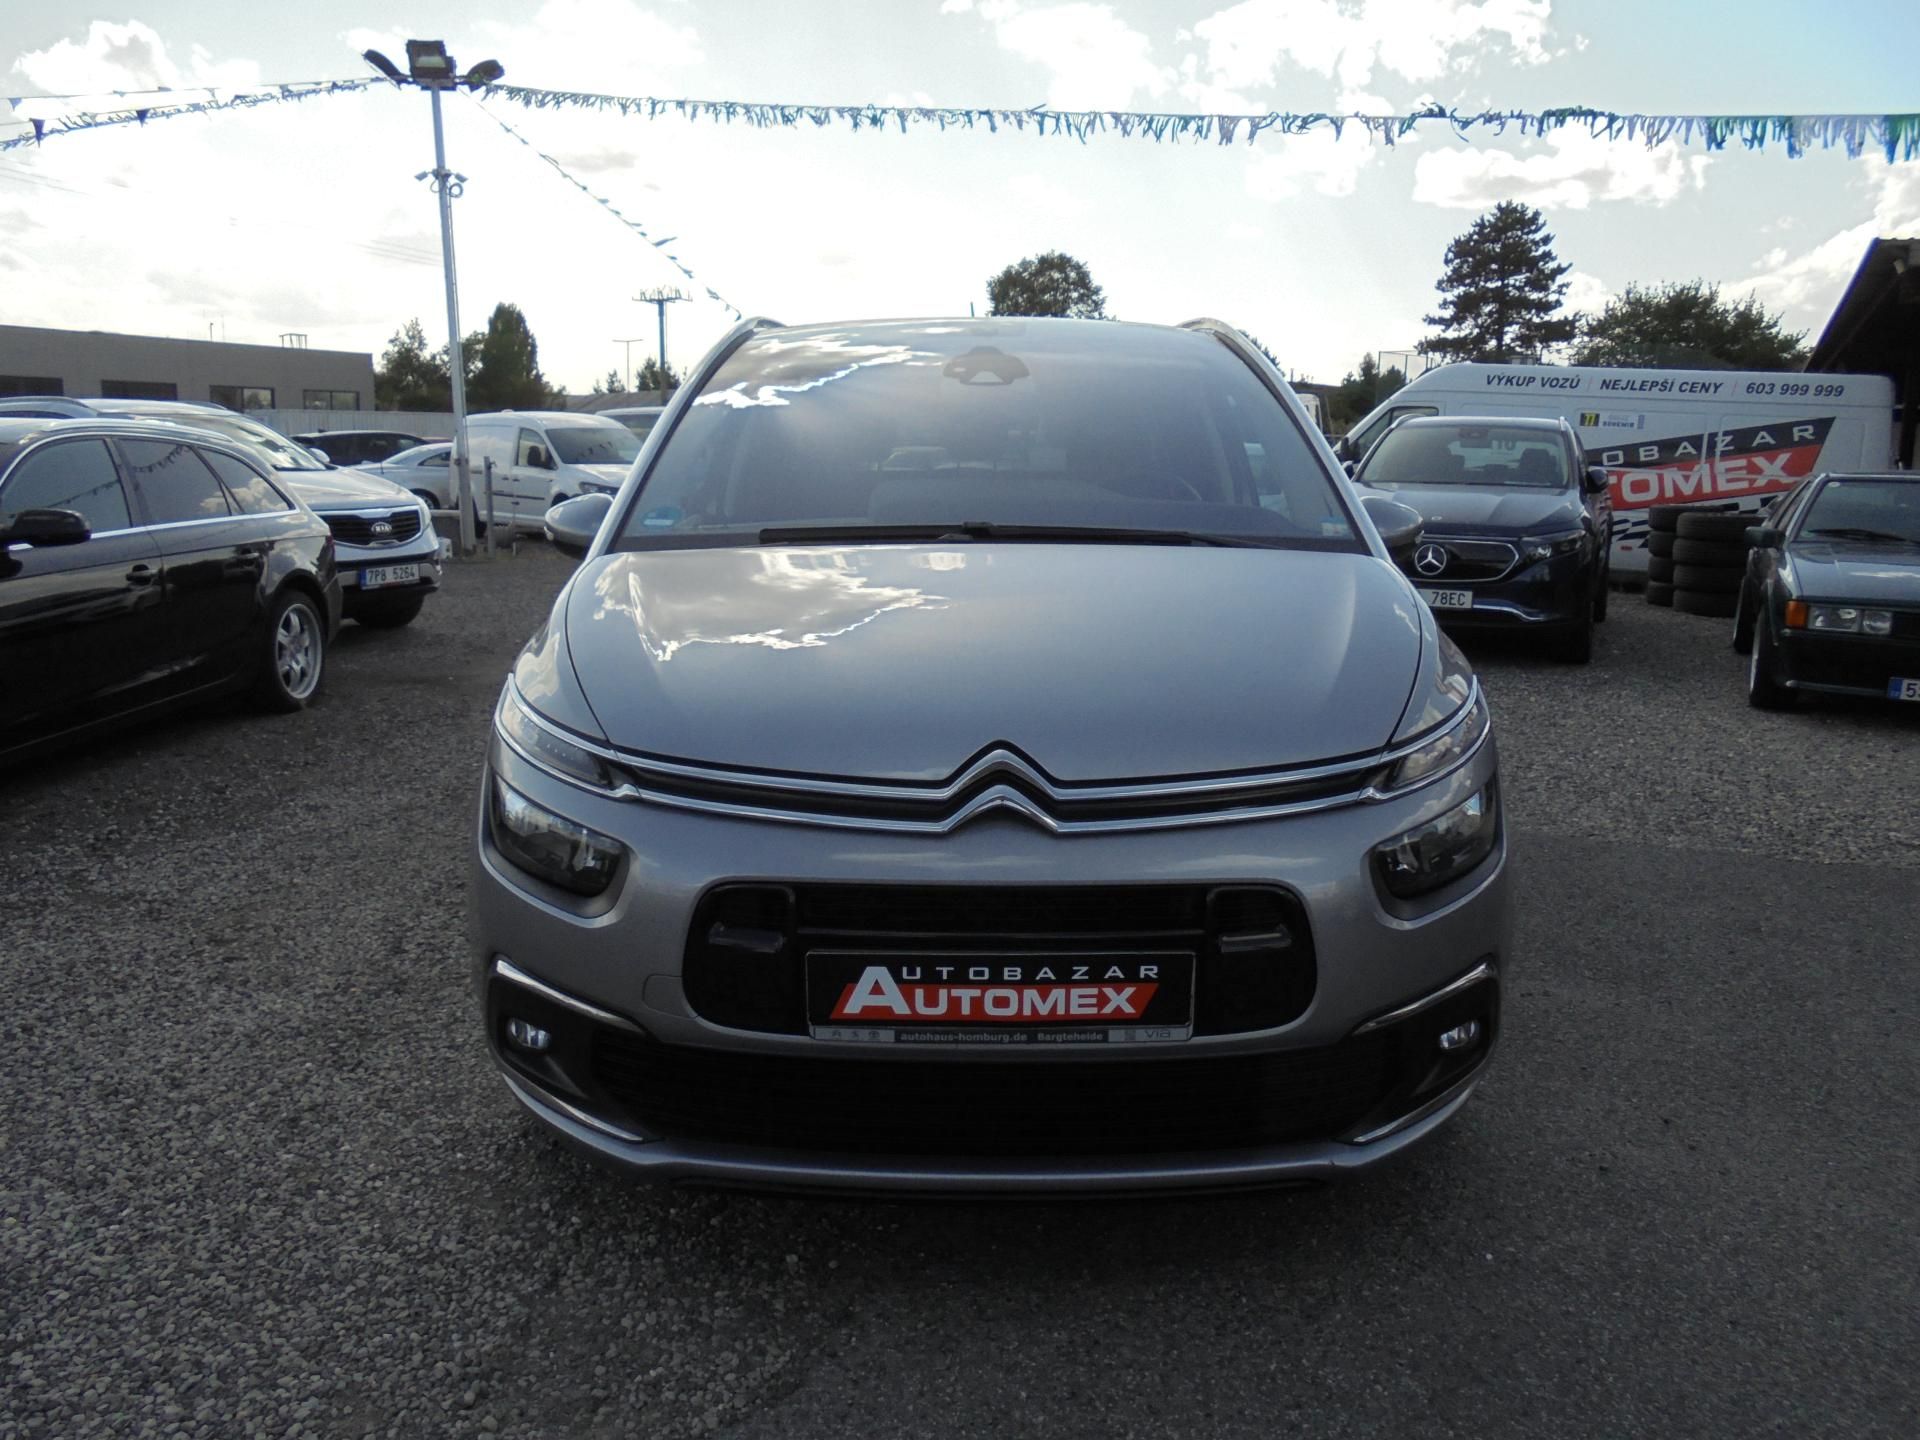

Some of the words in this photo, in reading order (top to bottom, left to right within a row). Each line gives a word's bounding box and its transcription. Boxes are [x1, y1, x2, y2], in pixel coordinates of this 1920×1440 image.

[1486, 372, 1536, 387] VÝKUP
[1600, 377, 1675, 393] NEJLEPŠÍ
[1678, 381, 1724, 394] CENY
[1746, 382, 1775, 395] 603
[1779, 383, 1809, 396] 999
[1813, 384, 1845, 398] 999
[1608, 452, 1794, 503] OMEX
[1431, 591, 1466, 607] 78EC
[842, 965, 1137, 1017] AUTOMEX
[900, 1031, 1028, 1043] autohaus-homburg.de
[1037, 1031, 1104, 1042] Bargteheide
